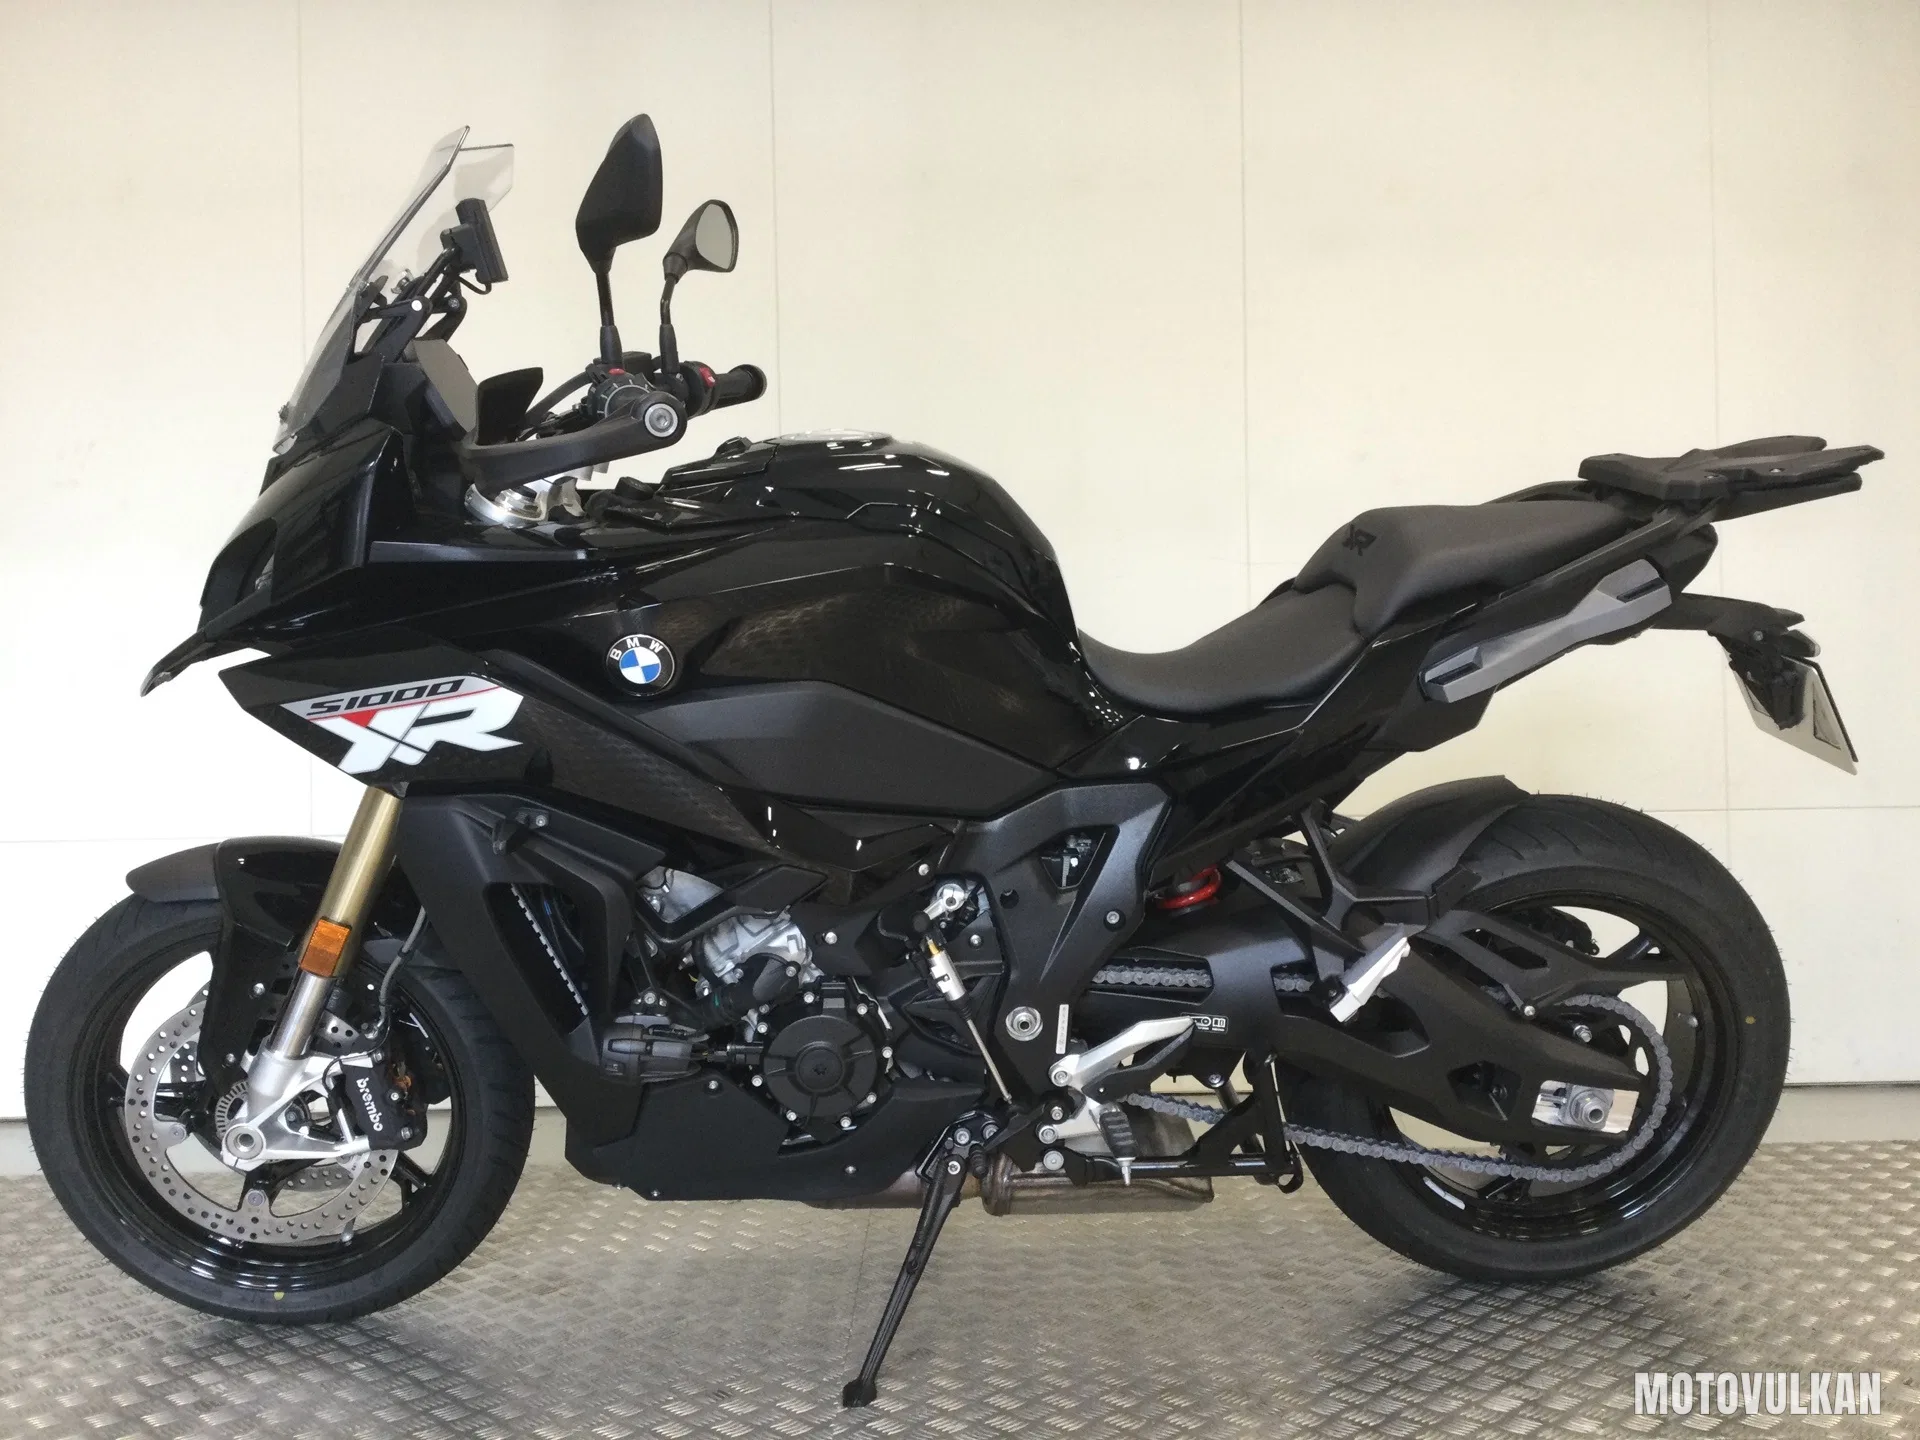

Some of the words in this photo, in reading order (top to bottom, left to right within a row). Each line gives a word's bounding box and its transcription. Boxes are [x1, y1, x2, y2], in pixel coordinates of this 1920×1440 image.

[609, 637, 664, 661] BMW
[306, 678, 466, 716] S1000
[309, 687, 524, 775] XR
[356, 1077, 383, 1132] brembo
